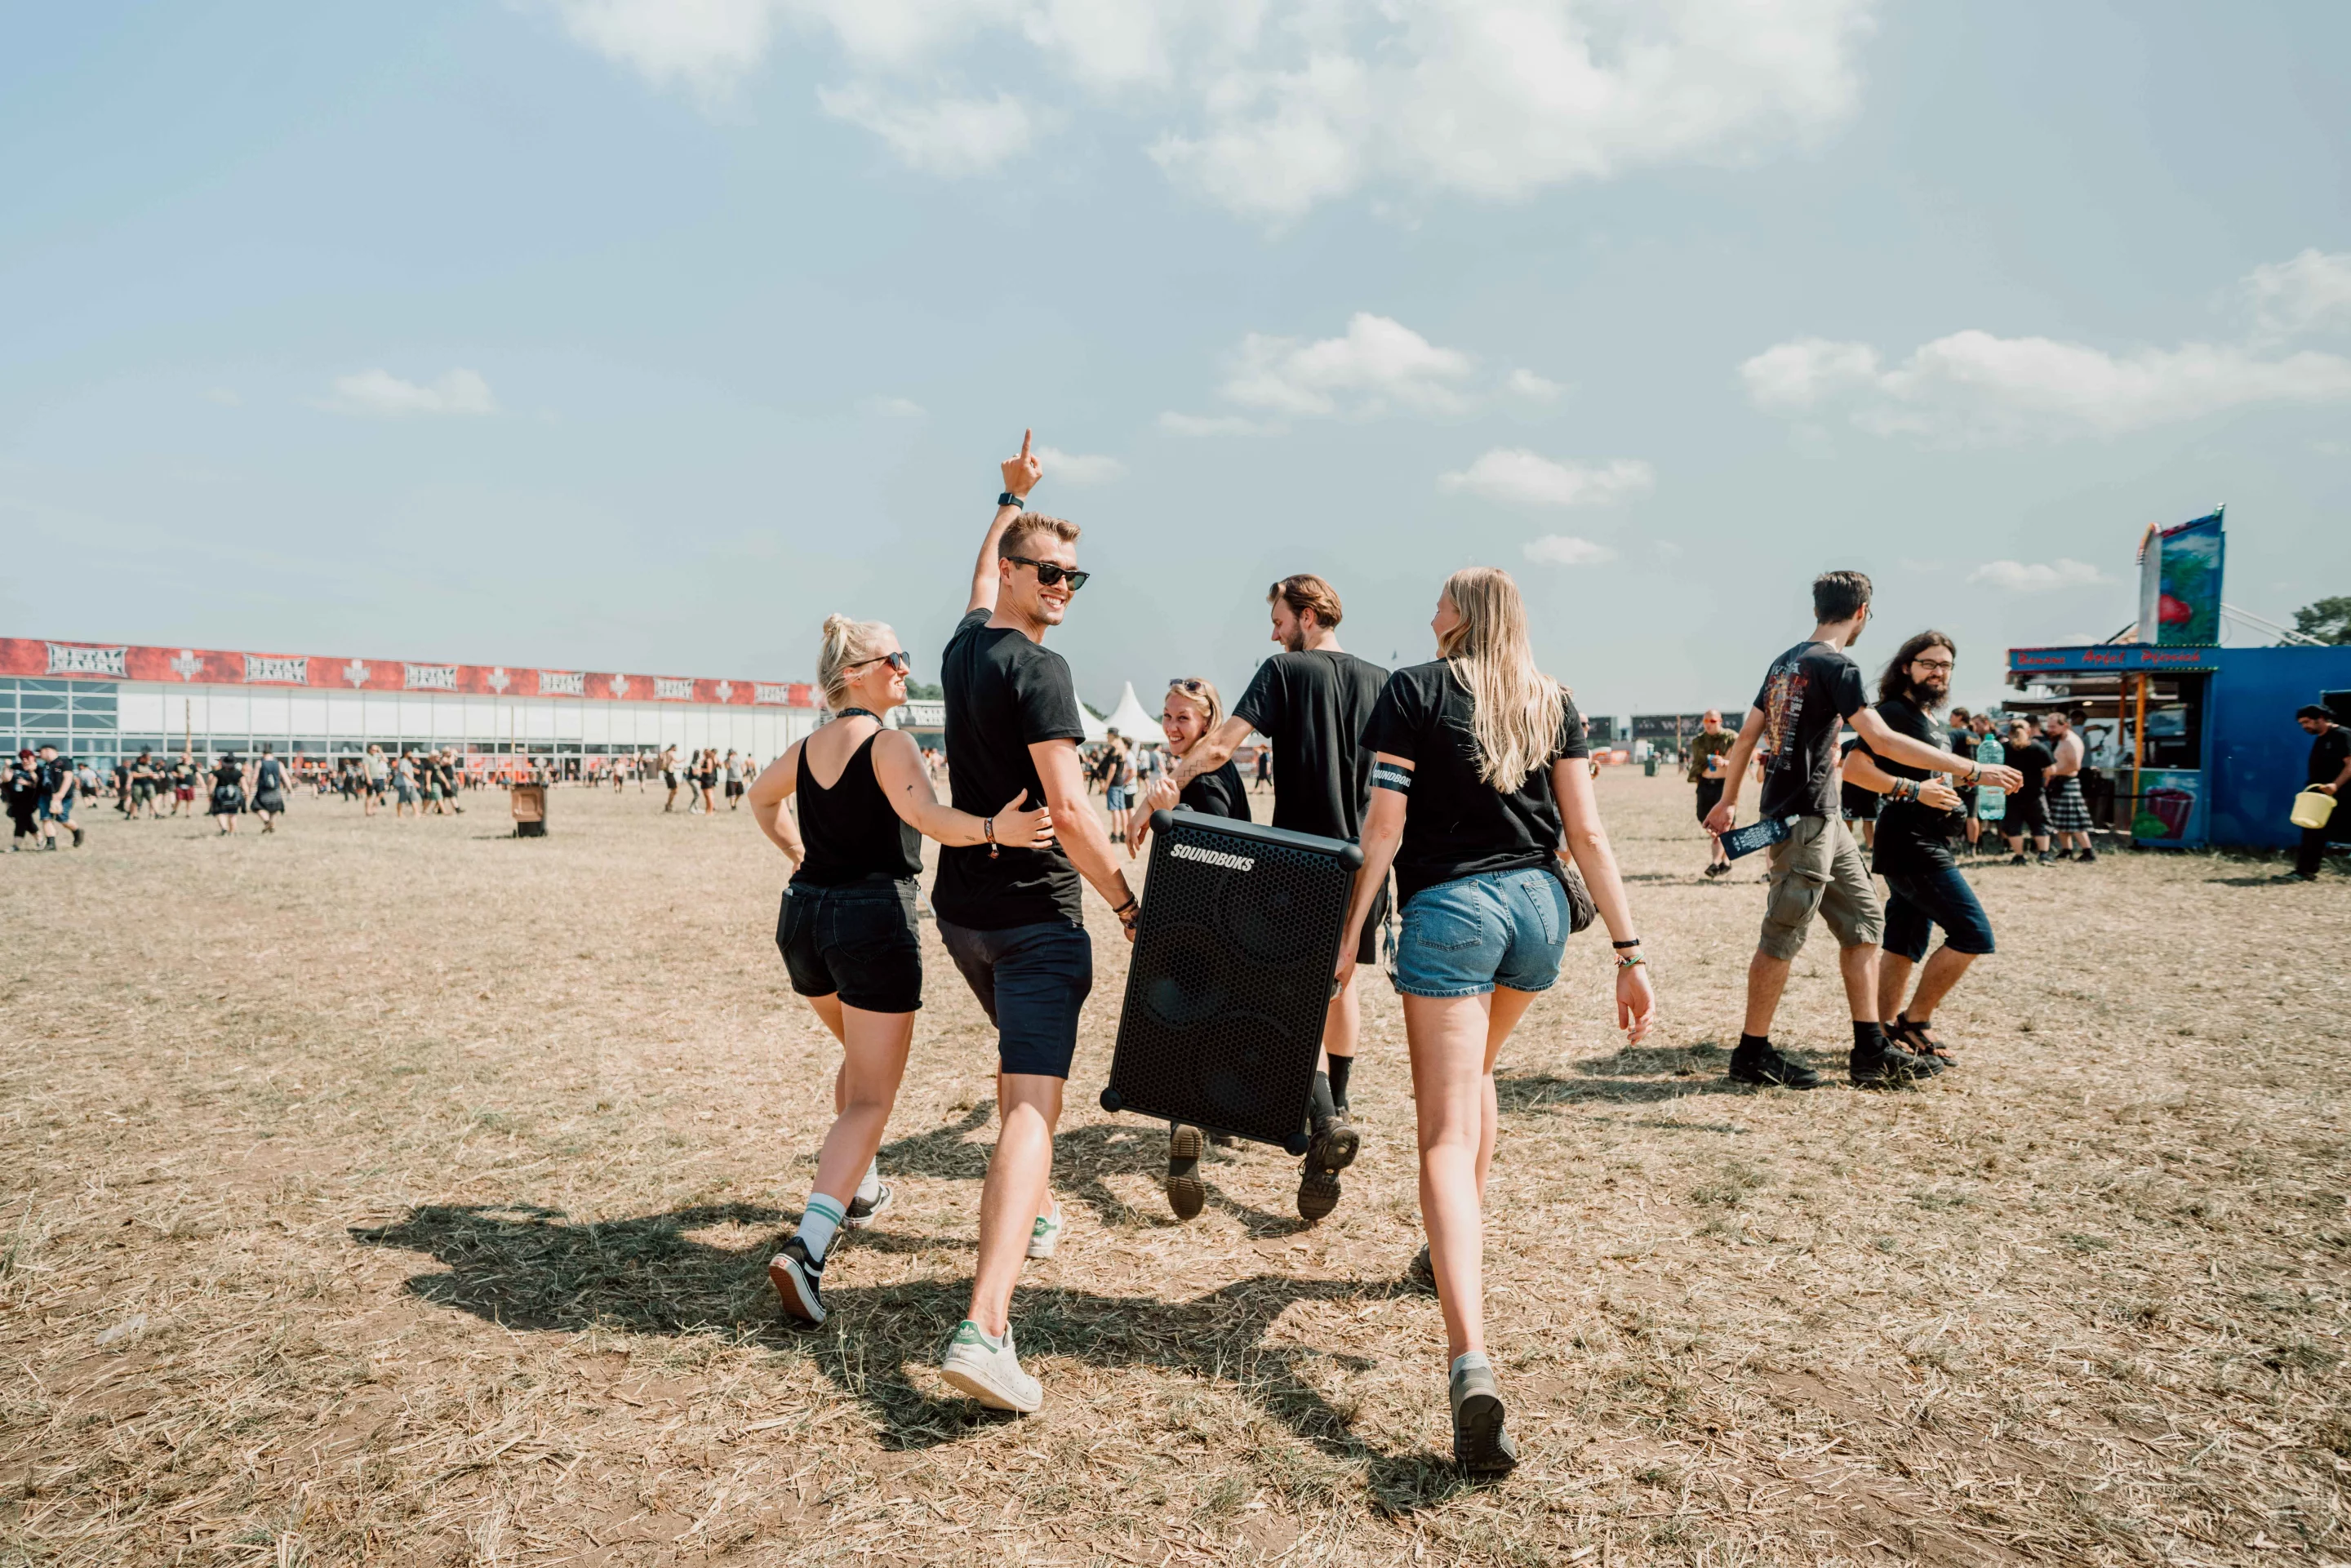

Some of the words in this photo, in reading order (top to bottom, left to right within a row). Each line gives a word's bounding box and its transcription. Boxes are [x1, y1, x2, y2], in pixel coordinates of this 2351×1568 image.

[2082, 650, 2124, 665] Apfel
[1372, 769, 1411, 787] SOUNDBOKS
[1171, 843, 1255, 872] SOUNDBOKS
